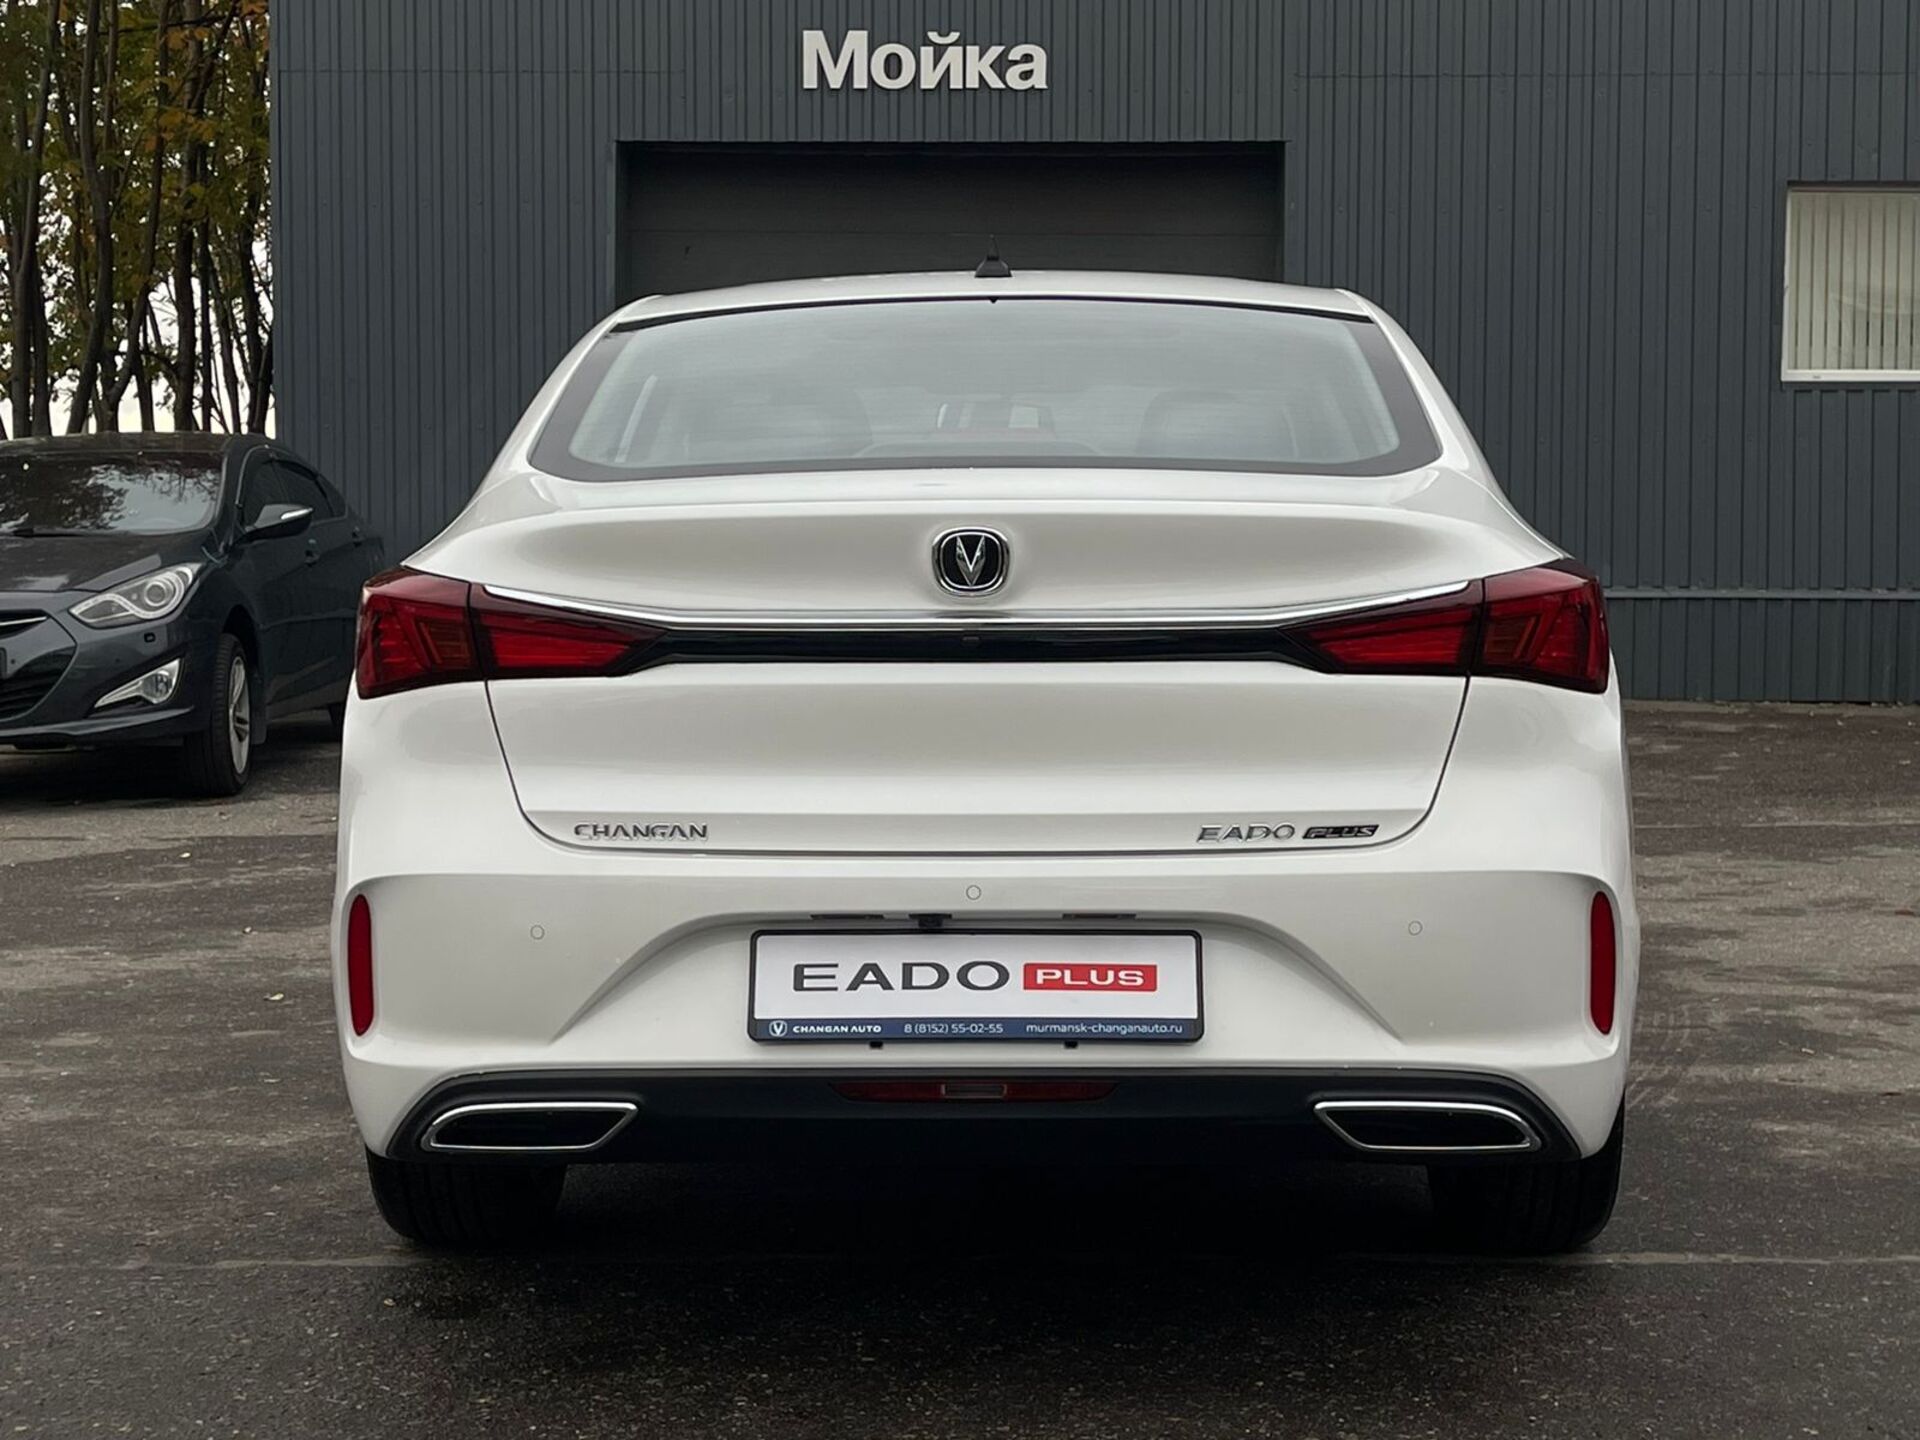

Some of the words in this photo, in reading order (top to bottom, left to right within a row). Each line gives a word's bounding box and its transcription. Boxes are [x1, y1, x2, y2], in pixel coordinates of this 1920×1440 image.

[803, 30, 1048, 91] Мойка
[574, 823, 708, 841] CHANGAN
[1197, 822, 1296, 843] EADO
[1306, 825, 1378, 839] PLUS
[793, 960, 1010, 992] EADO
[1035, 968, 1145, 987] PLUS
[792, 1024, 848, 1034] CHANGAN
[850, 1024, 882, 1034] AUTO
[903, 1023, 912, 1034] 8
[914, 1023, 949, 1036] (8152)
[951, 1023, 1004, 1034] 55-02-55
[1026, 1022, 1183, 1035] murmansk-changanauto.ru
